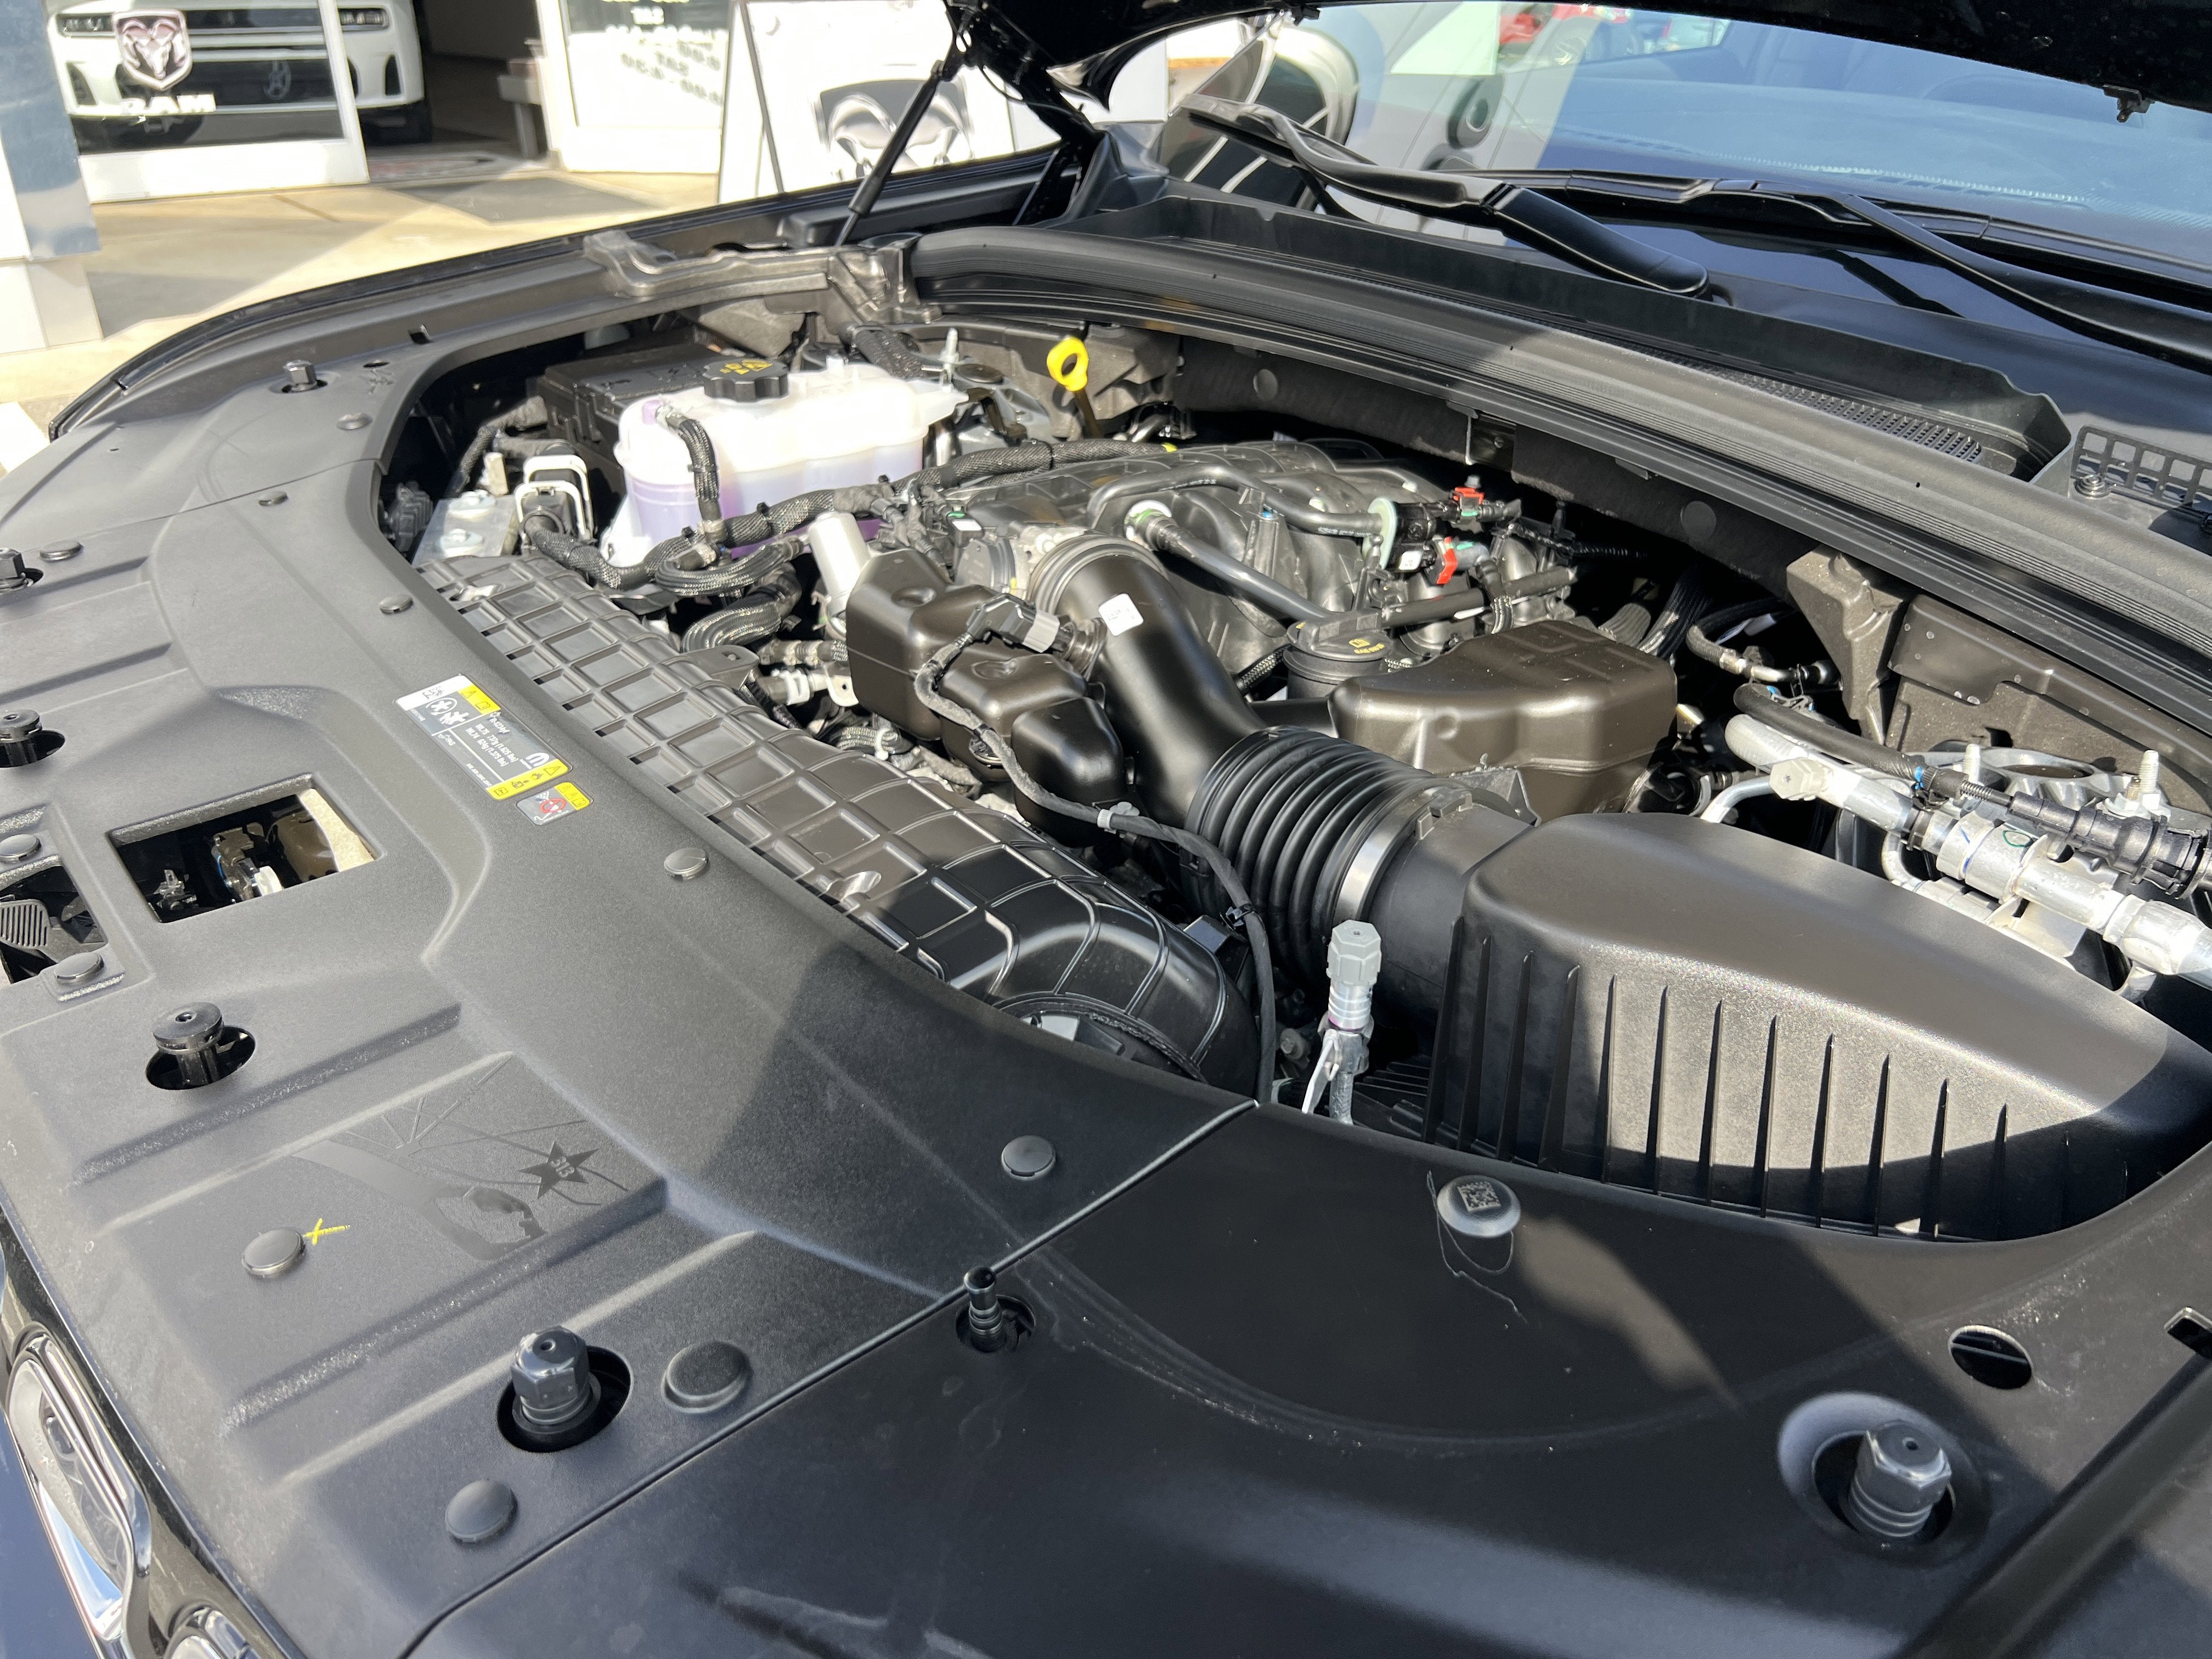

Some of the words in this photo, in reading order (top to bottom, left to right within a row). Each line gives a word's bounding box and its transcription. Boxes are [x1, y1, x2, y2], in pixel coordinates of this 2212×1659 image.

[120, 94, 216, 114] RAM
[466, 727, 480, 738] WL74
[477, 738, 489, 749] 624g
[497, 757, 509, 766] lbs)
[476, 724, 490, 735] WL75
[487, 735, 499, 746] 737g
[507, 753, 518, 763] lbs)
[550, 1156, 575, 1178] 313
